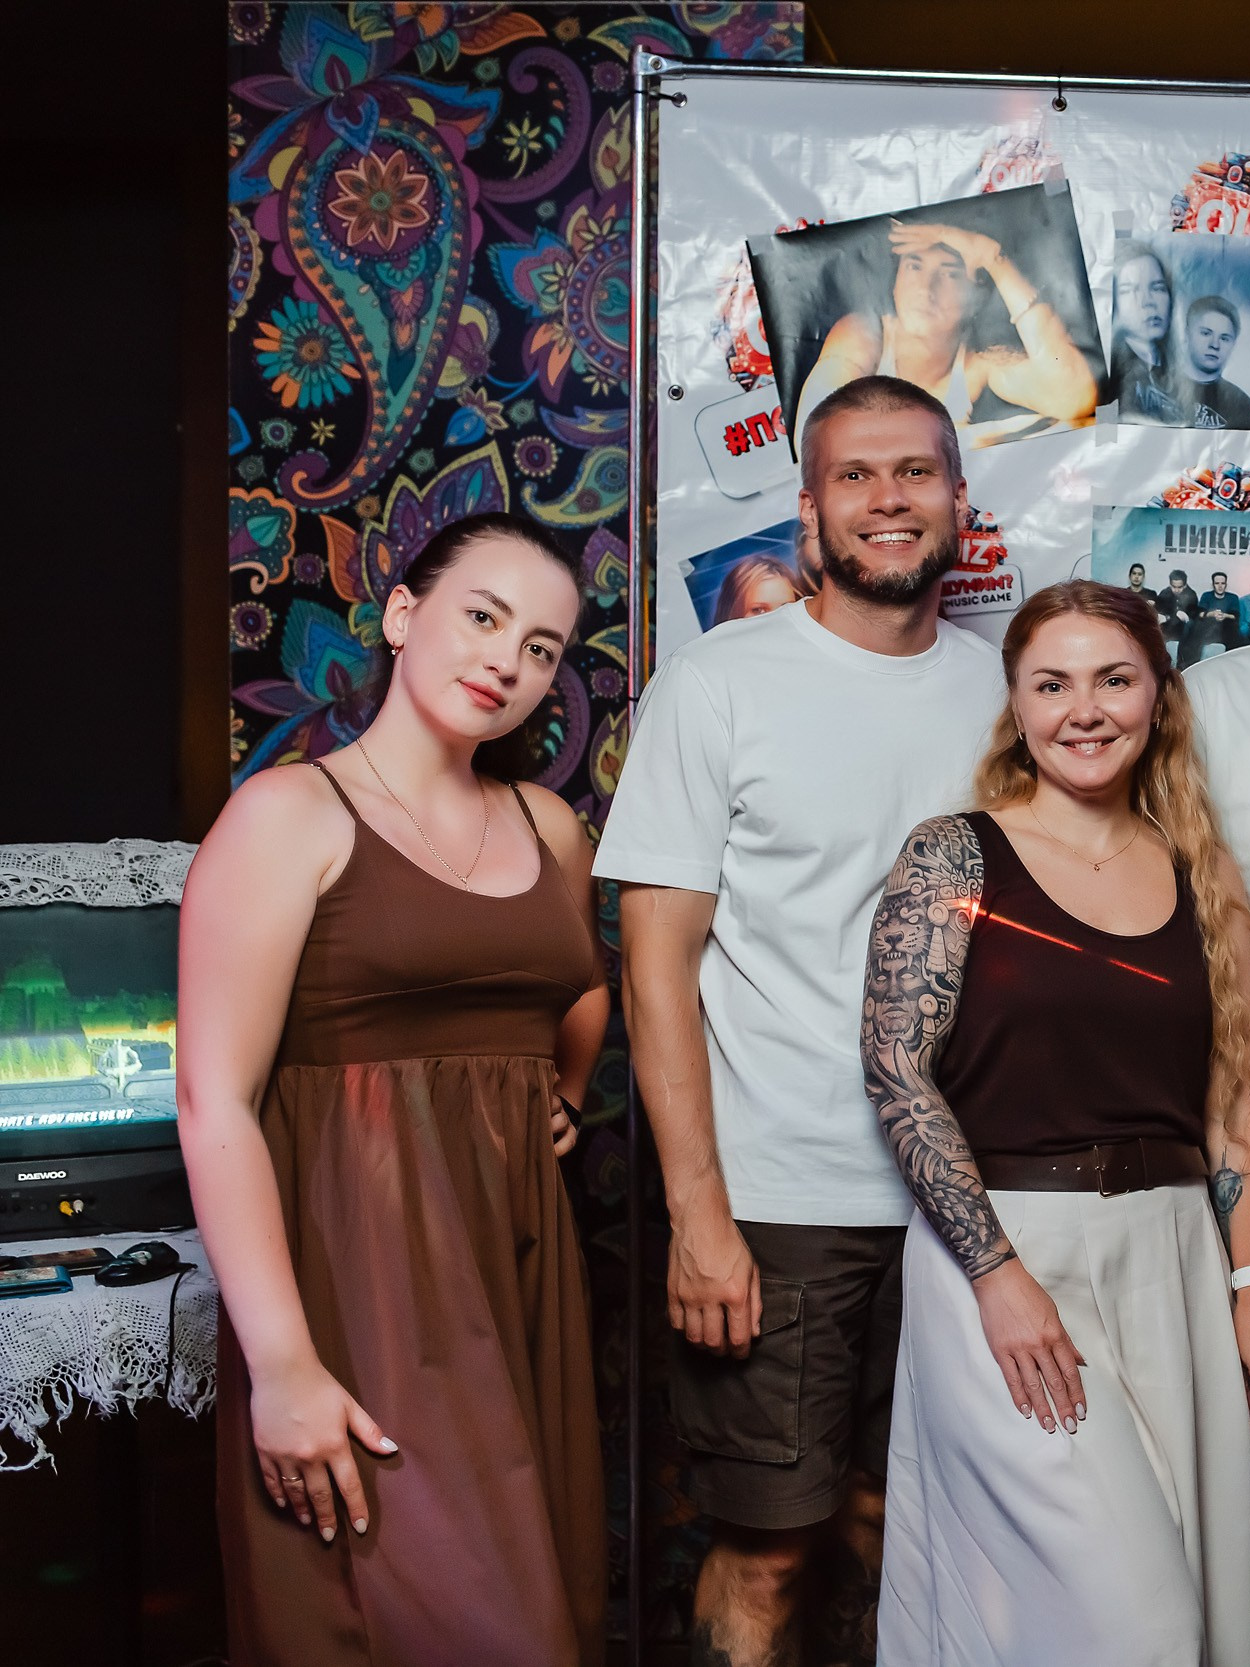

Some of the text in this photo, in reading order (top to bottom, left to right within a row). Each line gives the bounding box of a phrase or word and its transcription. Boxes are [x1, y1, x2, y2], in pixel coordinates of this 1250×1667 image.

[959, 537, 991, 566] IZ
[944, 592, 1012, 608] MUSIC GAME
[18, 1171, 67, 1181] DAEWOO
